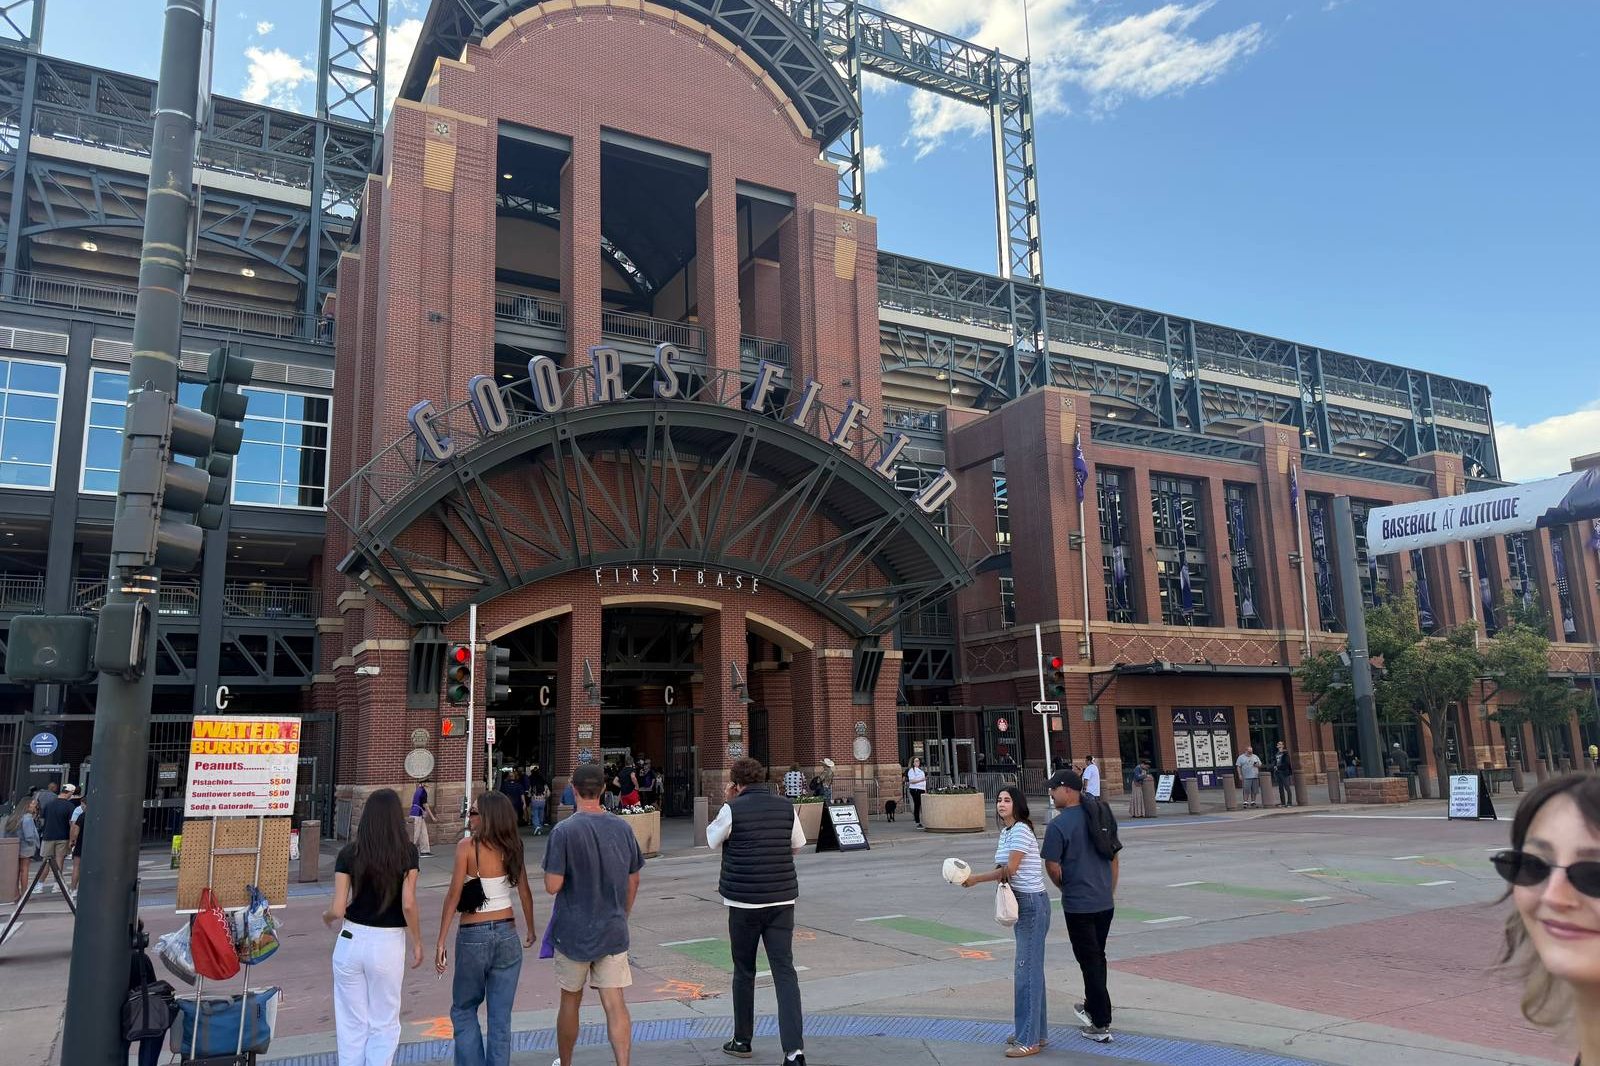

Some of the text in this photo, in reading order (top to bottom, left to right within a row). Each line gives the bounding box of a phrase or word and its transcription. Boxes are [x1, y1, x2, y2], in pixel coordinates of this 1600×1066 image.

[407, 342, 957, 513] COORS FIELD
[1381, 497, 1521, 540] BASEBALL AT ALTITUDE
[595, 568, 759, 592] FIRST BASE
[216, 685, 230, 710] C
[540, 685, 550, 706] C
[664, 685, 674, 705] C
[193, 721, 280, 739] WATER
[191, 741, 298, 755] BURRITOS 6
[194, 761, 244, 771] Peanuts
[190, 803, 210, 811] Soda
